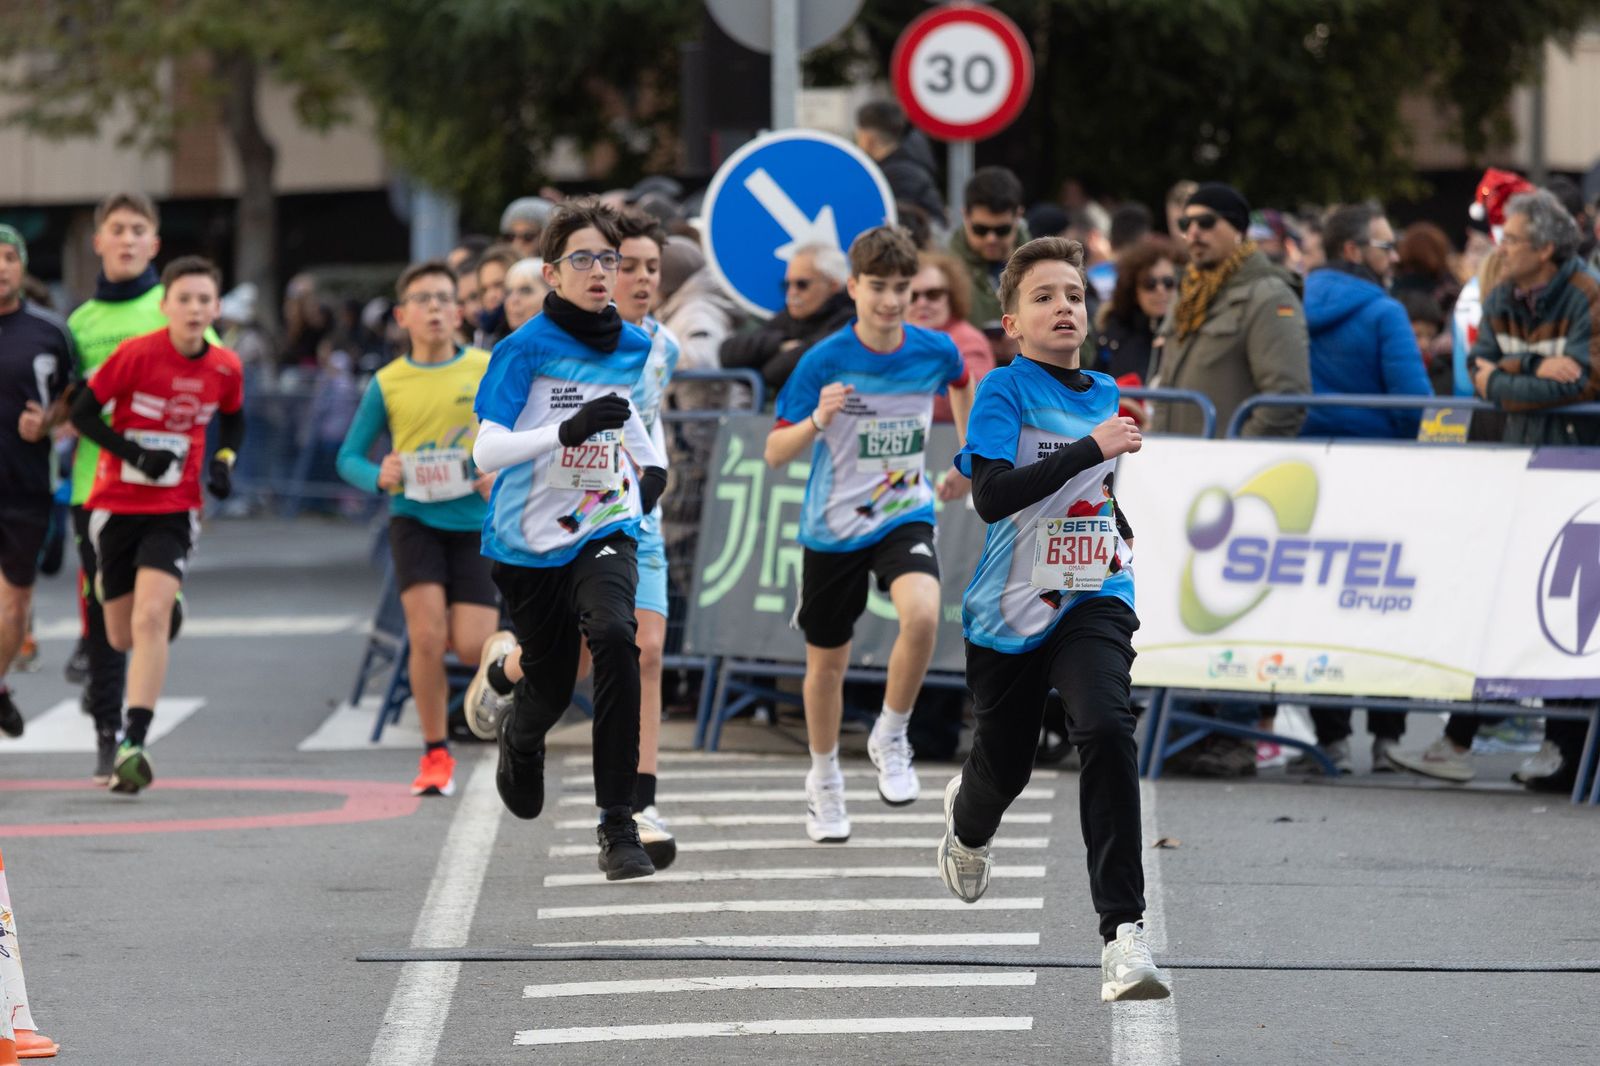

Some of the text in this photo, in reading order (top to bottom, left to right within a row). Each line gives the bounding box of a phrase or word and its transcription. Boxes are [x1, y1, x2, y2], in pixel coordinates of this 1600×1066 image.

[926, 54, 995, 95] 30
[587, 432, 617, 442] ETEL
[867, 431, 914, 456] 6267
[1037, 442, 1052, 450] XLI
[561, 445, 608, 469] 6225
[1062, 520, 1113, 533] SETEL
[1046, 536, 1108, 565] 6304
[1222, 537, 1416, 588] SETEL
[1338, 588, 1412, 614] Grupo
